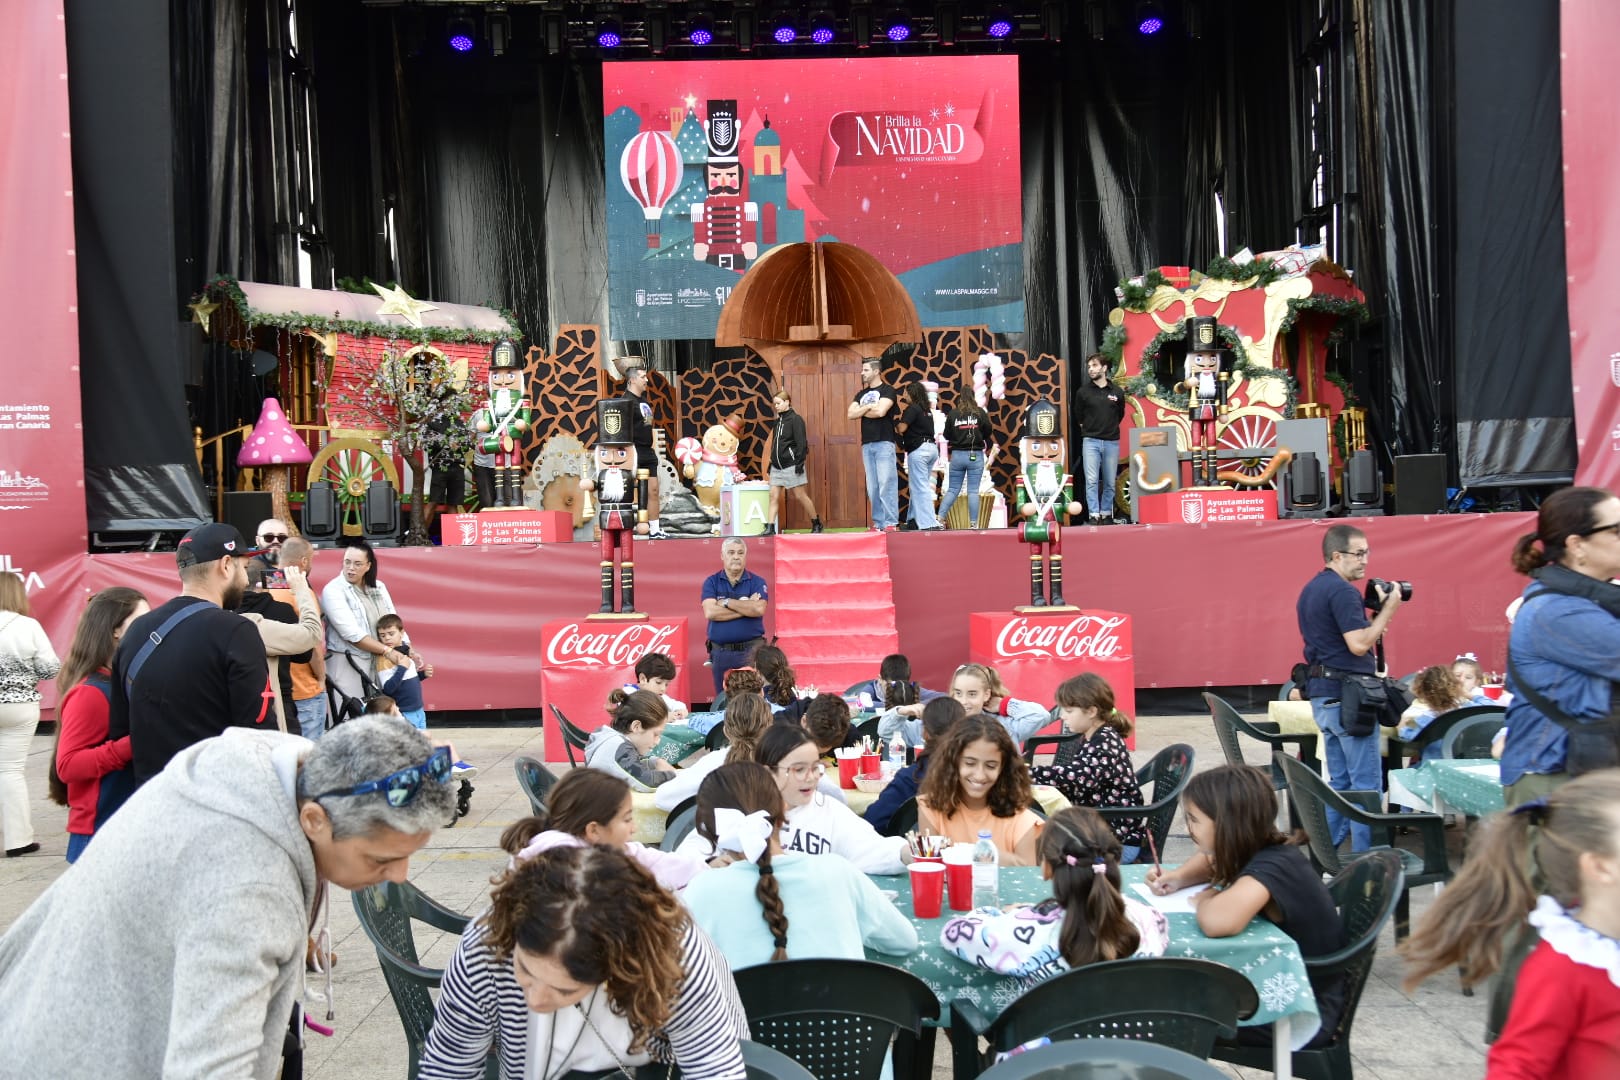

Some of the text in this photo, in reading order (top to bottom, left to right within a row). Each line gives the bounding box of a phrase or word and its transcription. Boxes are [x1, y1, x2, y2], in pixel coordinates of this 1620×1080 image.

[885, 115, 922, 127] Brilla la
[855, 116, 965, 156] NAVIDAD
[16, 412, 51, 421] Palmas
[16, 421, 51, 429] Canaria
[1207, 498, 1264, 507] Ayuntamiento
[743, 500, 768, 525] A
[482, 520, 541, 528] Ayuntamiento
[513, 535, 541, 543] Canaria
[996, 615, 1127, 657] Coca-Cola
